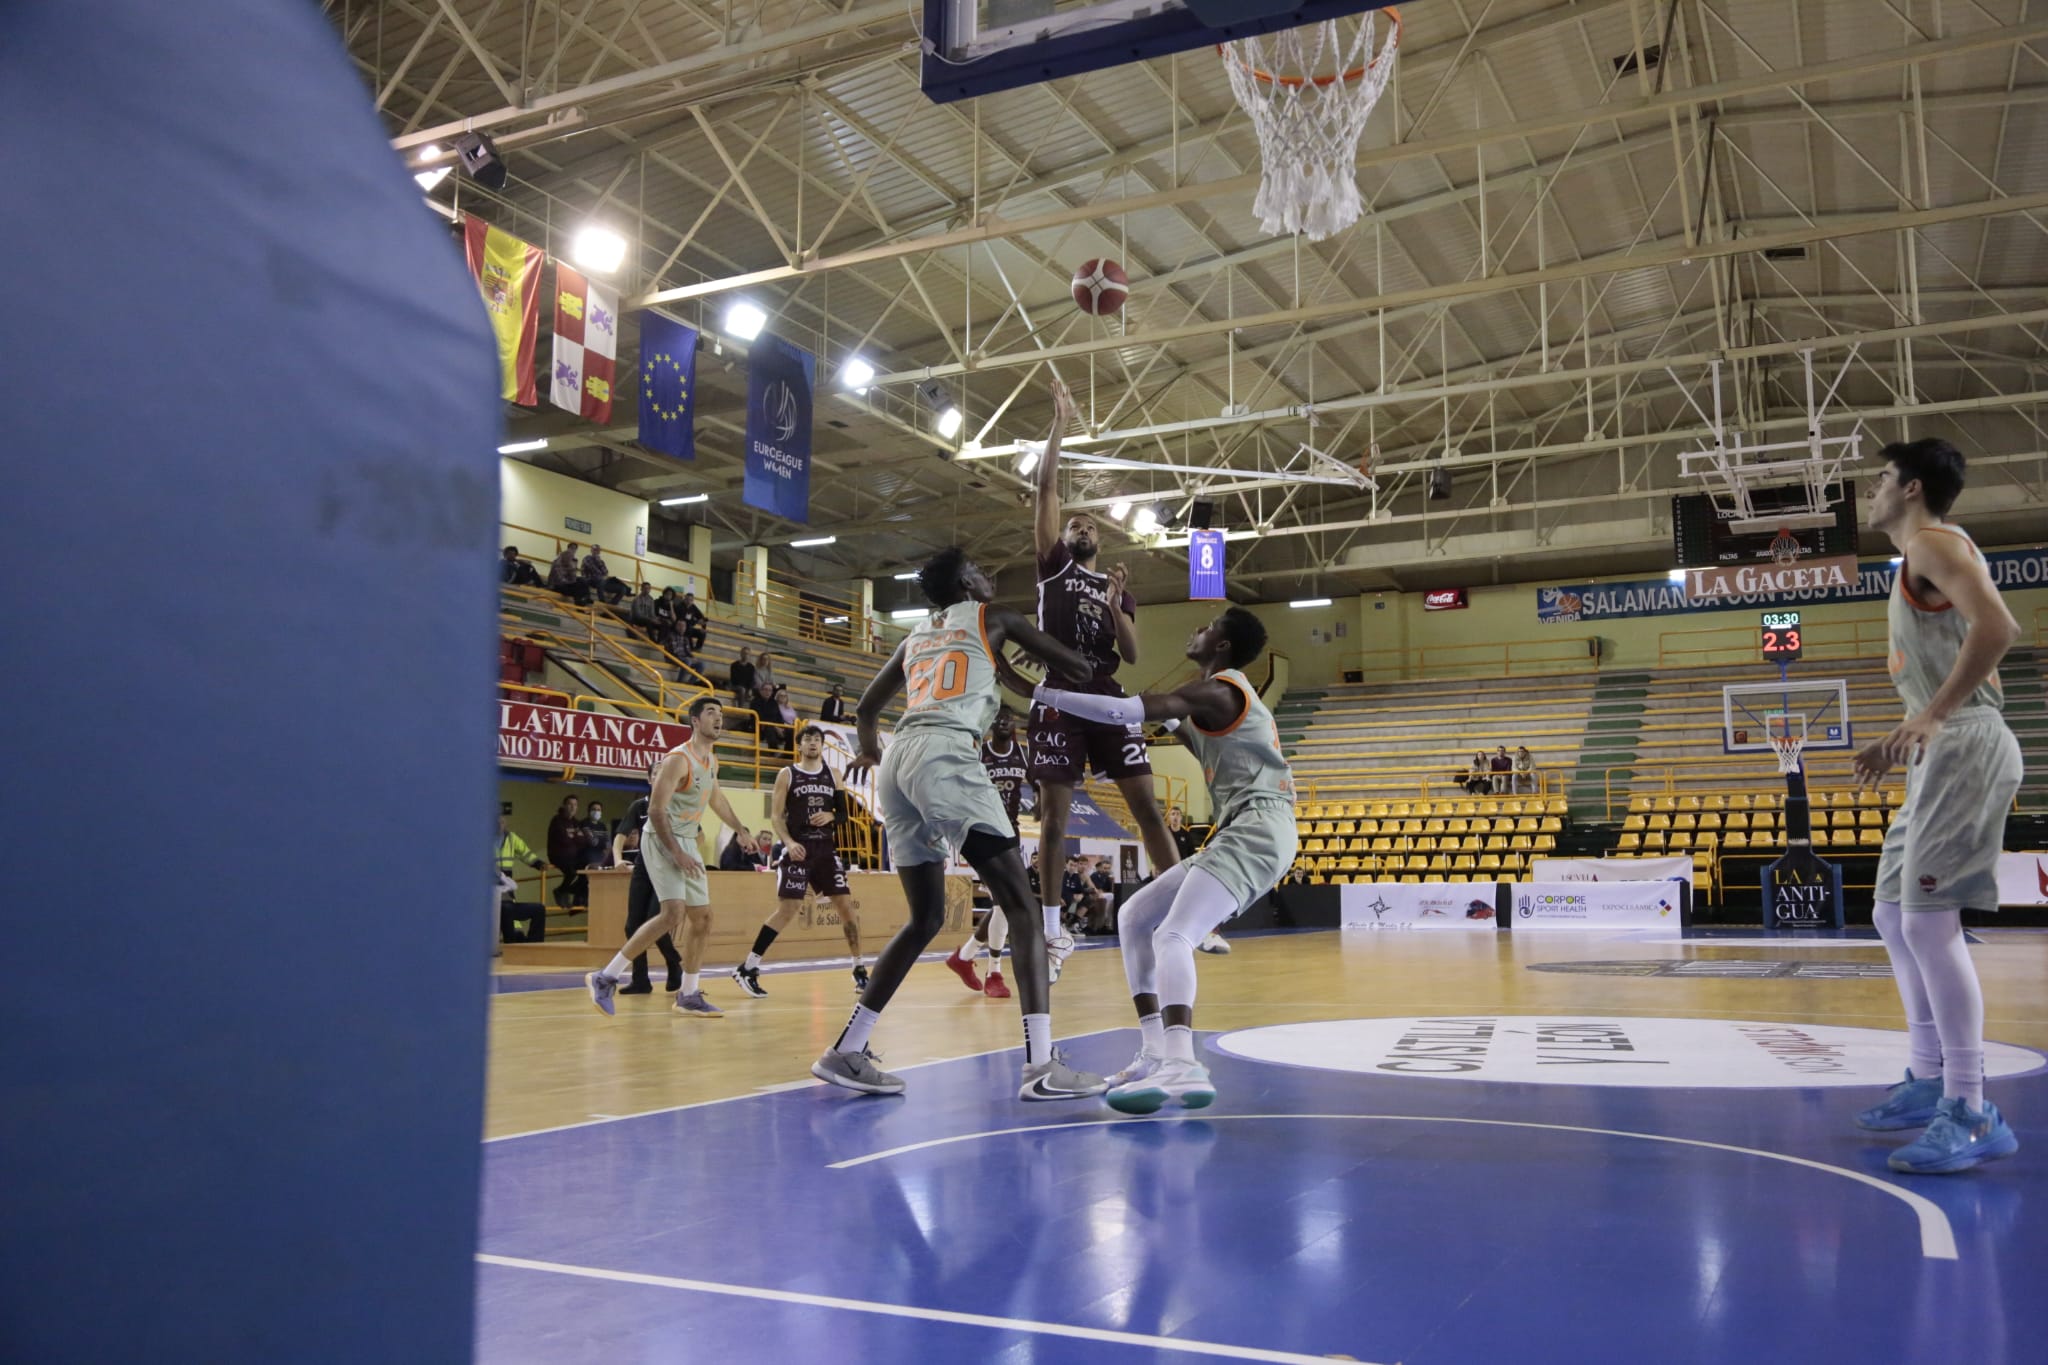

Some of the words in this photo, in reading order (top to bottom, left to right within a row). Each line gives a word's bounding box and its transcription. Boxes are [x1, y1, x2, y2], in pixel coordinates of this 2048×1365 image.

[1201, 544, 1214, 569] 8
[1693, 570, 1732, 597] LA
[1735, 565, 1848, 594] GACETA
[1763, 613, 1799, 625] 03:30
[1763, 631, 1800, 652] 2.3
[538, 738, 563, 761] DE
[569, 742, 590, 763] LA
[988, 767, 1026, 779] ORMES
[1774, 869, 1802, 885] LA
[1536, 895, 1586, 905] CORPORE
[1776, 885, 1830, 902] ANTI-
[1537, 905, 1559, 913] SPORT
[1560, 905, 1587, 913] HEALTH
[1776, 903, 1819, 919] GUA
[1376, 1019, 1497, 1072] CASTILLA
